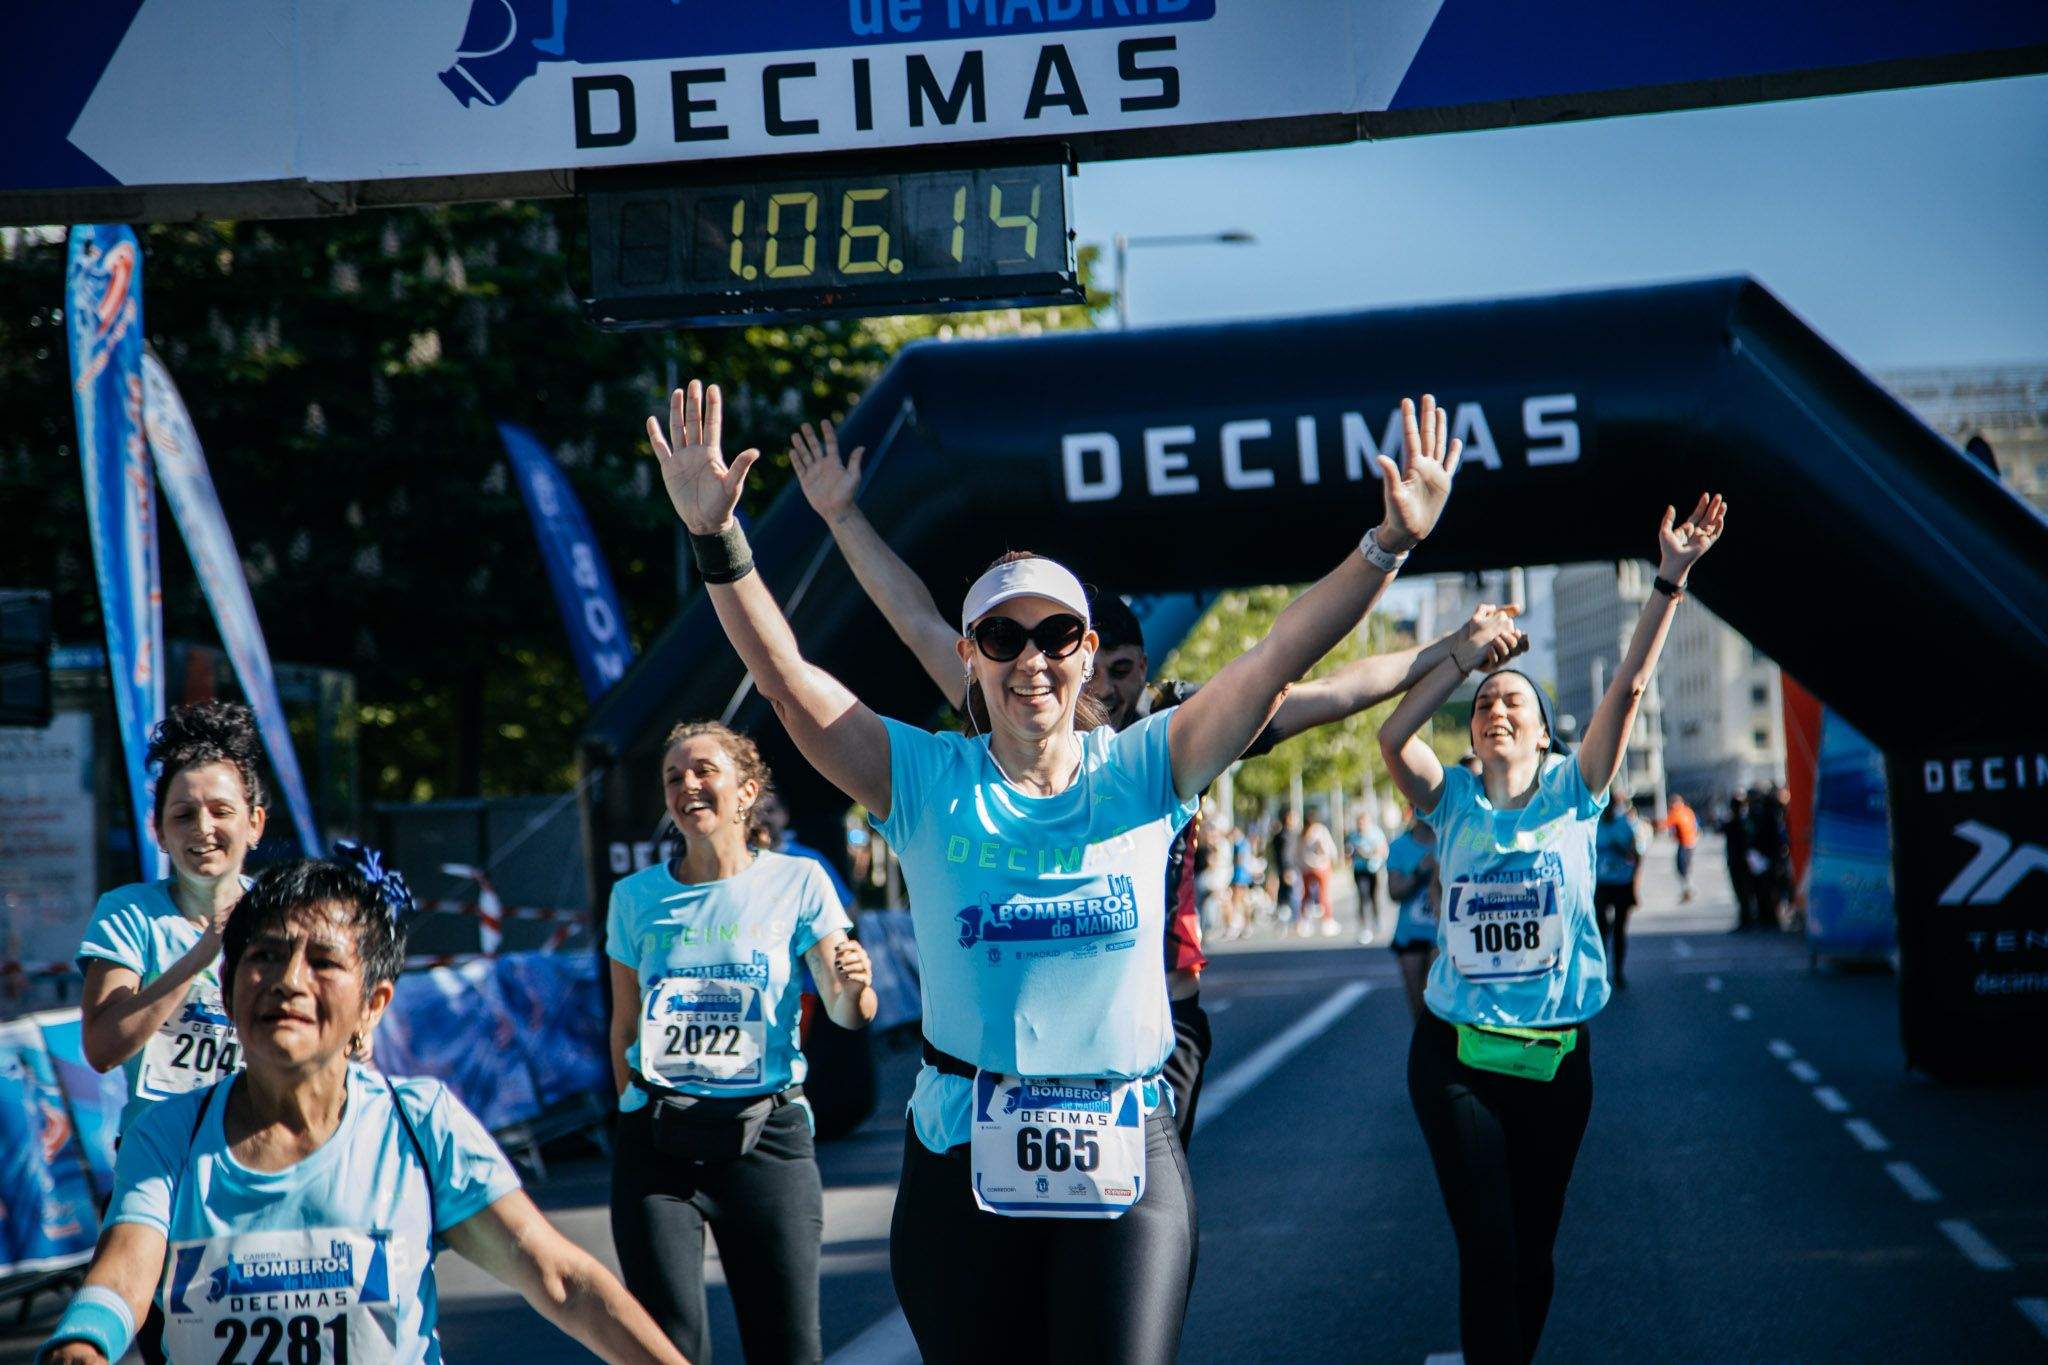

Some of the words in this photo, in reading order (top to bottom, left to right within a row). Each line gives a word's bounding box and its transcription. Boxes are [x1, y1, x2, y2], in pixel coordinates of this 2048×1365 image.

[572, 35, 1180, 149] DECIMAS
[1062, 393, 1581, 502] DECIMAS
[947, 825, 1137, 874] DECIM
[999, 892, 1134, 921] BOMBEROS
[1479, 911, 1538, 921] DECIMAS
[1052, 919, 1071, 938] de
[1076, 909, 1136, 936] MADRID
[1470, 920, 1540, 953] 1068
[681, 995, 740, 1004] BOMBEROS
[676, 1013, 739, 1022] DECIMAS
[171, 1034, 246, 1076] 204
[665, 1025, 740, 1057] 2022
[1031, 1086, 1109, 1102] BOMBEROS
[1021, 1110, 1108, 1126] DECIMAS
[1016, 1127, 1100, 1172] 665
[243, 1252, 282, 1261] CARRERA
[243, 1257, 350, 1278] BOMBEROS
[302, 1271, 350, 1289] MADRID
[230, 1290, 348, 1313] DECIMAS
[214, 1312, 348, 1365] 2281
